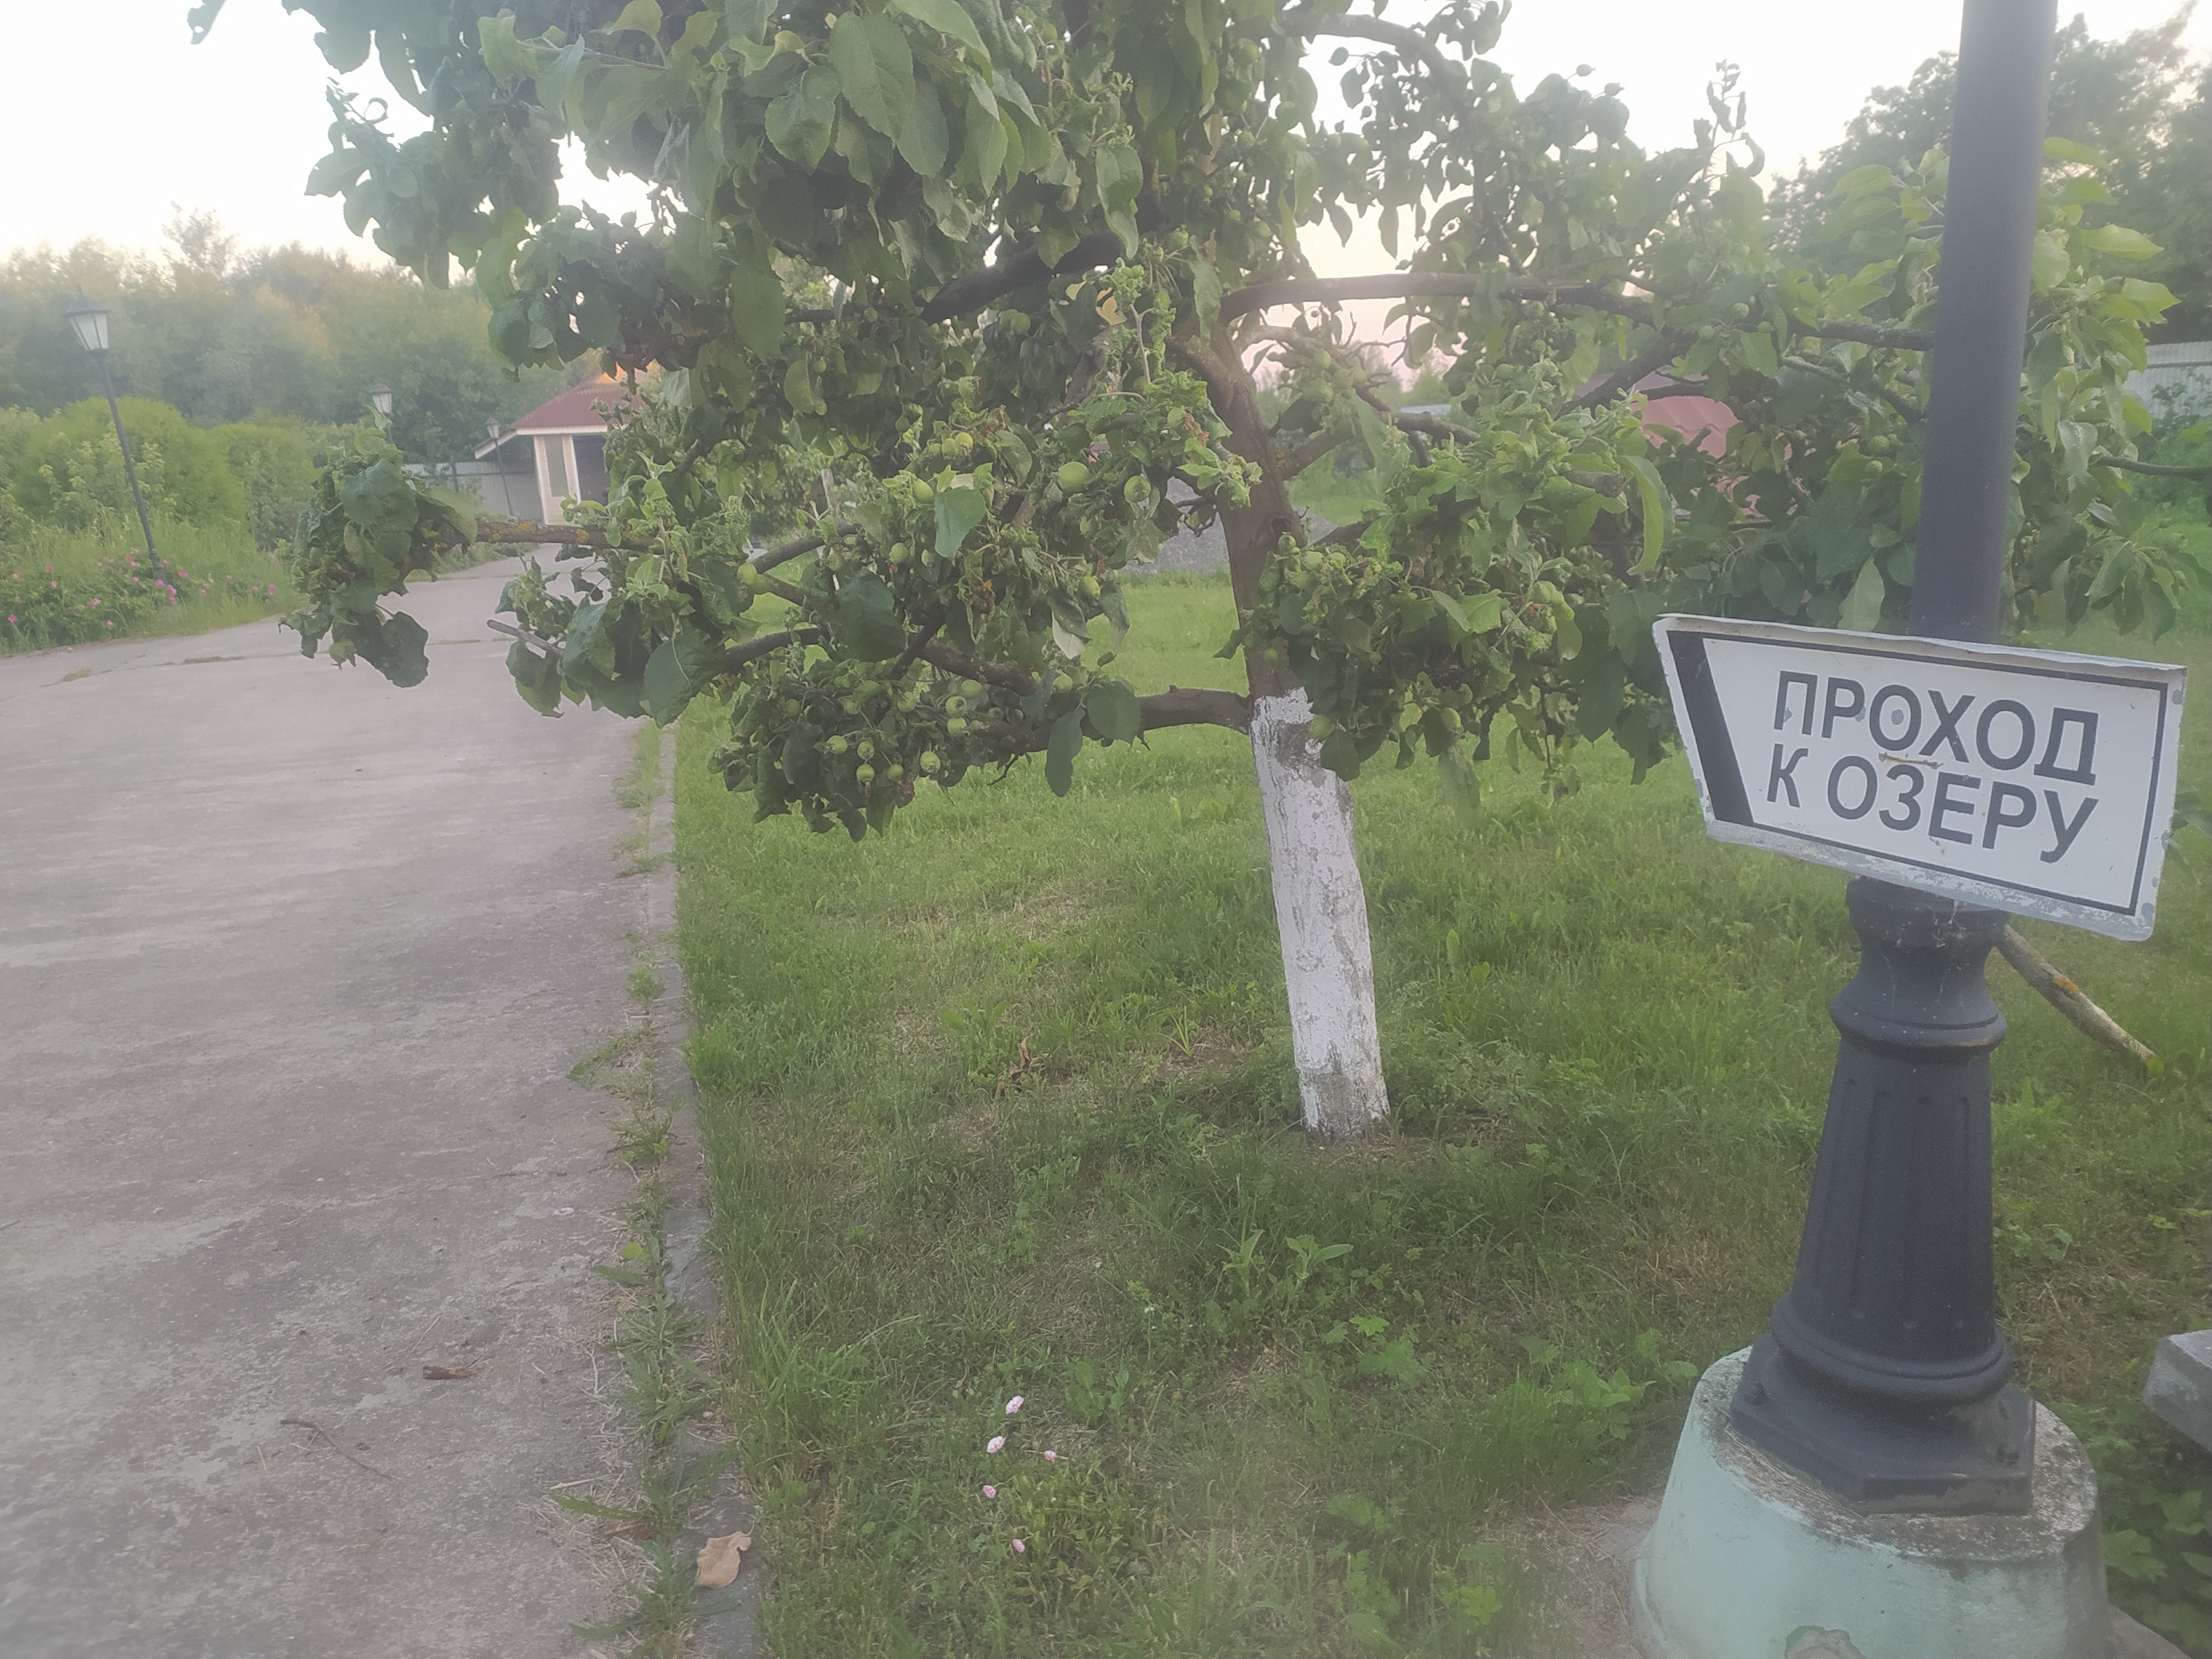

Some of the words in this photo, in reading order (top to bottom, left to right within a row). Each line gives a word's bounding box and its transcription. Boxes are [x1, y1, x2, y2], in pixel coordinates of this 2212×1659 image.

[1773, 670, 2099, 785] ПРОХОД
[1766, 743, 1809, 808] К
[1827, 755, 2099, 863] ОЗЕРУ
